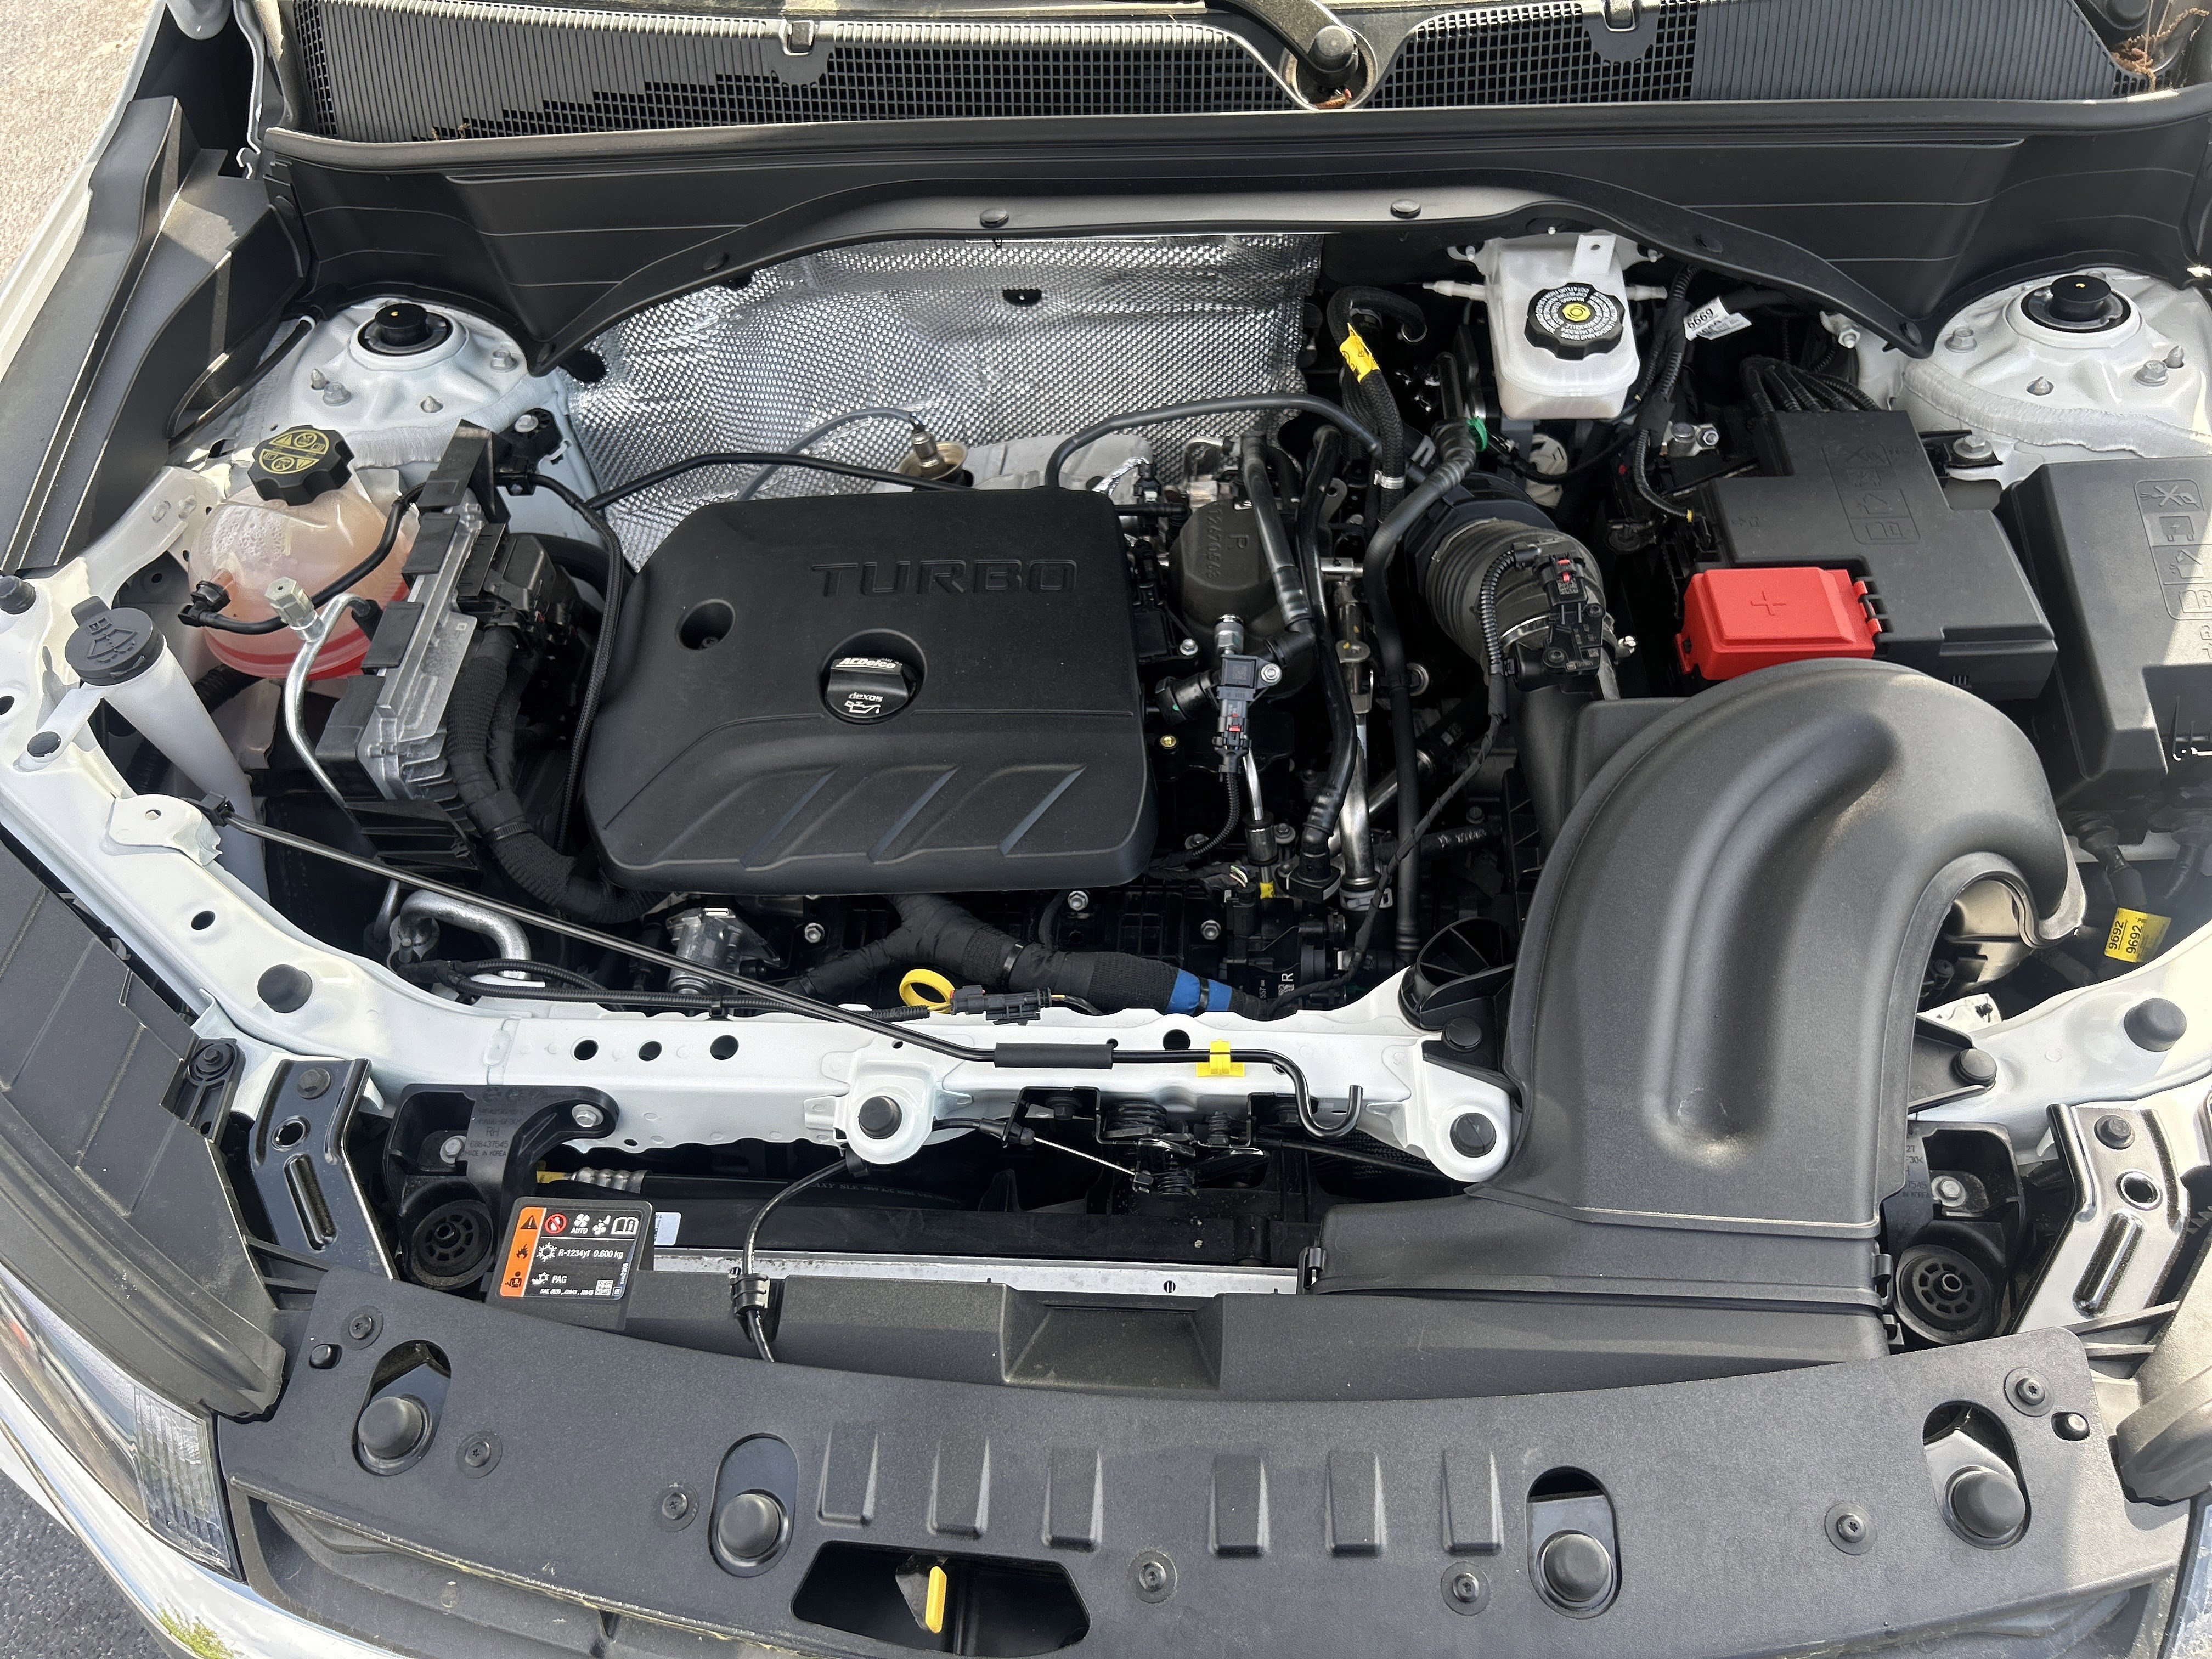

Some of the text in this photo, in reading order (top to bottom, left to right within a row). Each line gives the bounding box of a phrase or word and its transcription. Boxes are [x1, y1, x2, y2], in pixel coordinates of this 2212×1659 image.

[1687, 308, 1713, 329] 6669
[812, 558, 1077, 597] TURBO
[836, 658, 896, 669] ACDelco
[849, 692, 883, 702] dexos
[2108, 920, 2124, 950] 9692
[2125, 925, 2143, 954] 9692
[1281, 973, 1294, 982] R
[486, 1126, 500, 1136] RH
[558, 1249, 624, 1260] R-1234yf 0.600 kg
[551, 1275, 568, 1284] PAG
